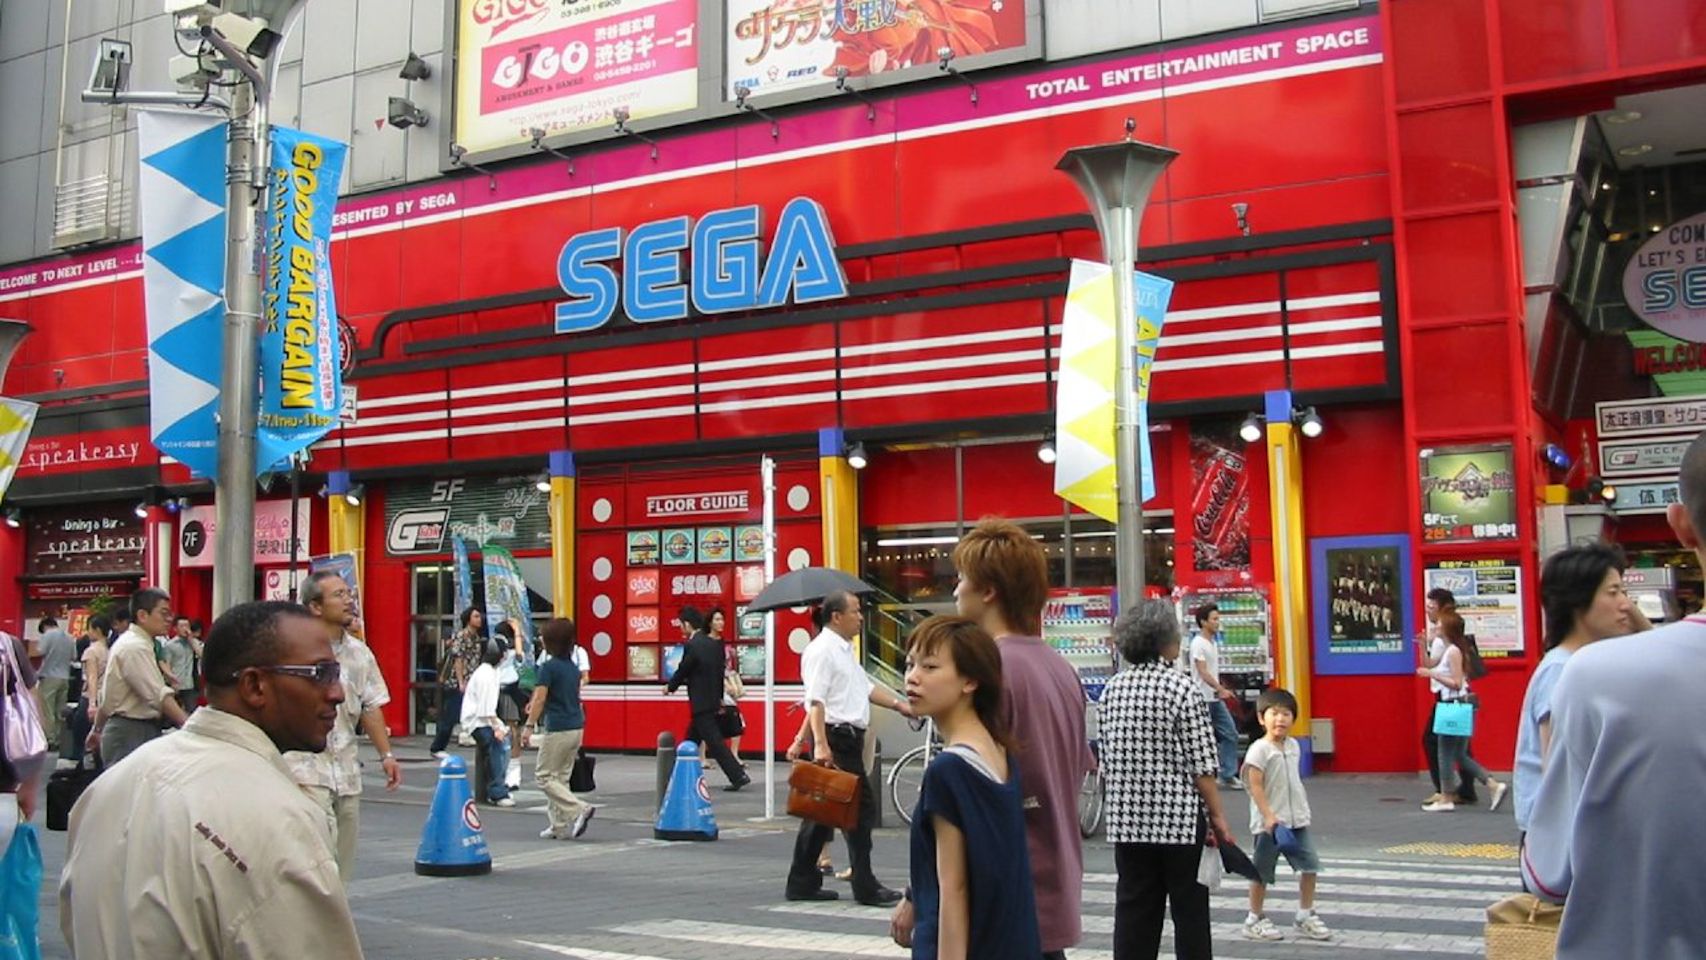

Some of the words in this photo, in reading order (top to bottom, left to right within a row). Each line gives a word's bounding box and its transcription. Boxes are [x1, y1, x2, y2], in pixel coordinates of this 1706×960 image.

[1026, 77, 1090, 100] TOTAL
[1101, 42, 1283, 88] ENTERTAINMENT
[1295, 28, 1369, 55] SPACE
[292, 142, 323, 243] GOOD
[332, 204, 389, 226] ESENTED
[395, 201, 413, 217] BY
[419, 192, 456, 211] SEGA
[0, 272, 38, 290] ELCOME
[42, 269, 56, 282] TO
[57, 264, 83, 279] NEXT
[88, 257, 118, 274] LEVEL
[555, 196, 849, 334] SEGA
[1638, 250, 1685, 268] LET'S
[281, 245, 316, 410] BARGAIN
[29, 442, 139, 472] speakeasy
[647, 498, 696, 514] FLOOR
[700, 494, 749, 510] GUIDE
[49, 534, 147, 559] speakeasy
[184, 532, 198, 547] 7F
[671, 574, 722, 595] SEGA
